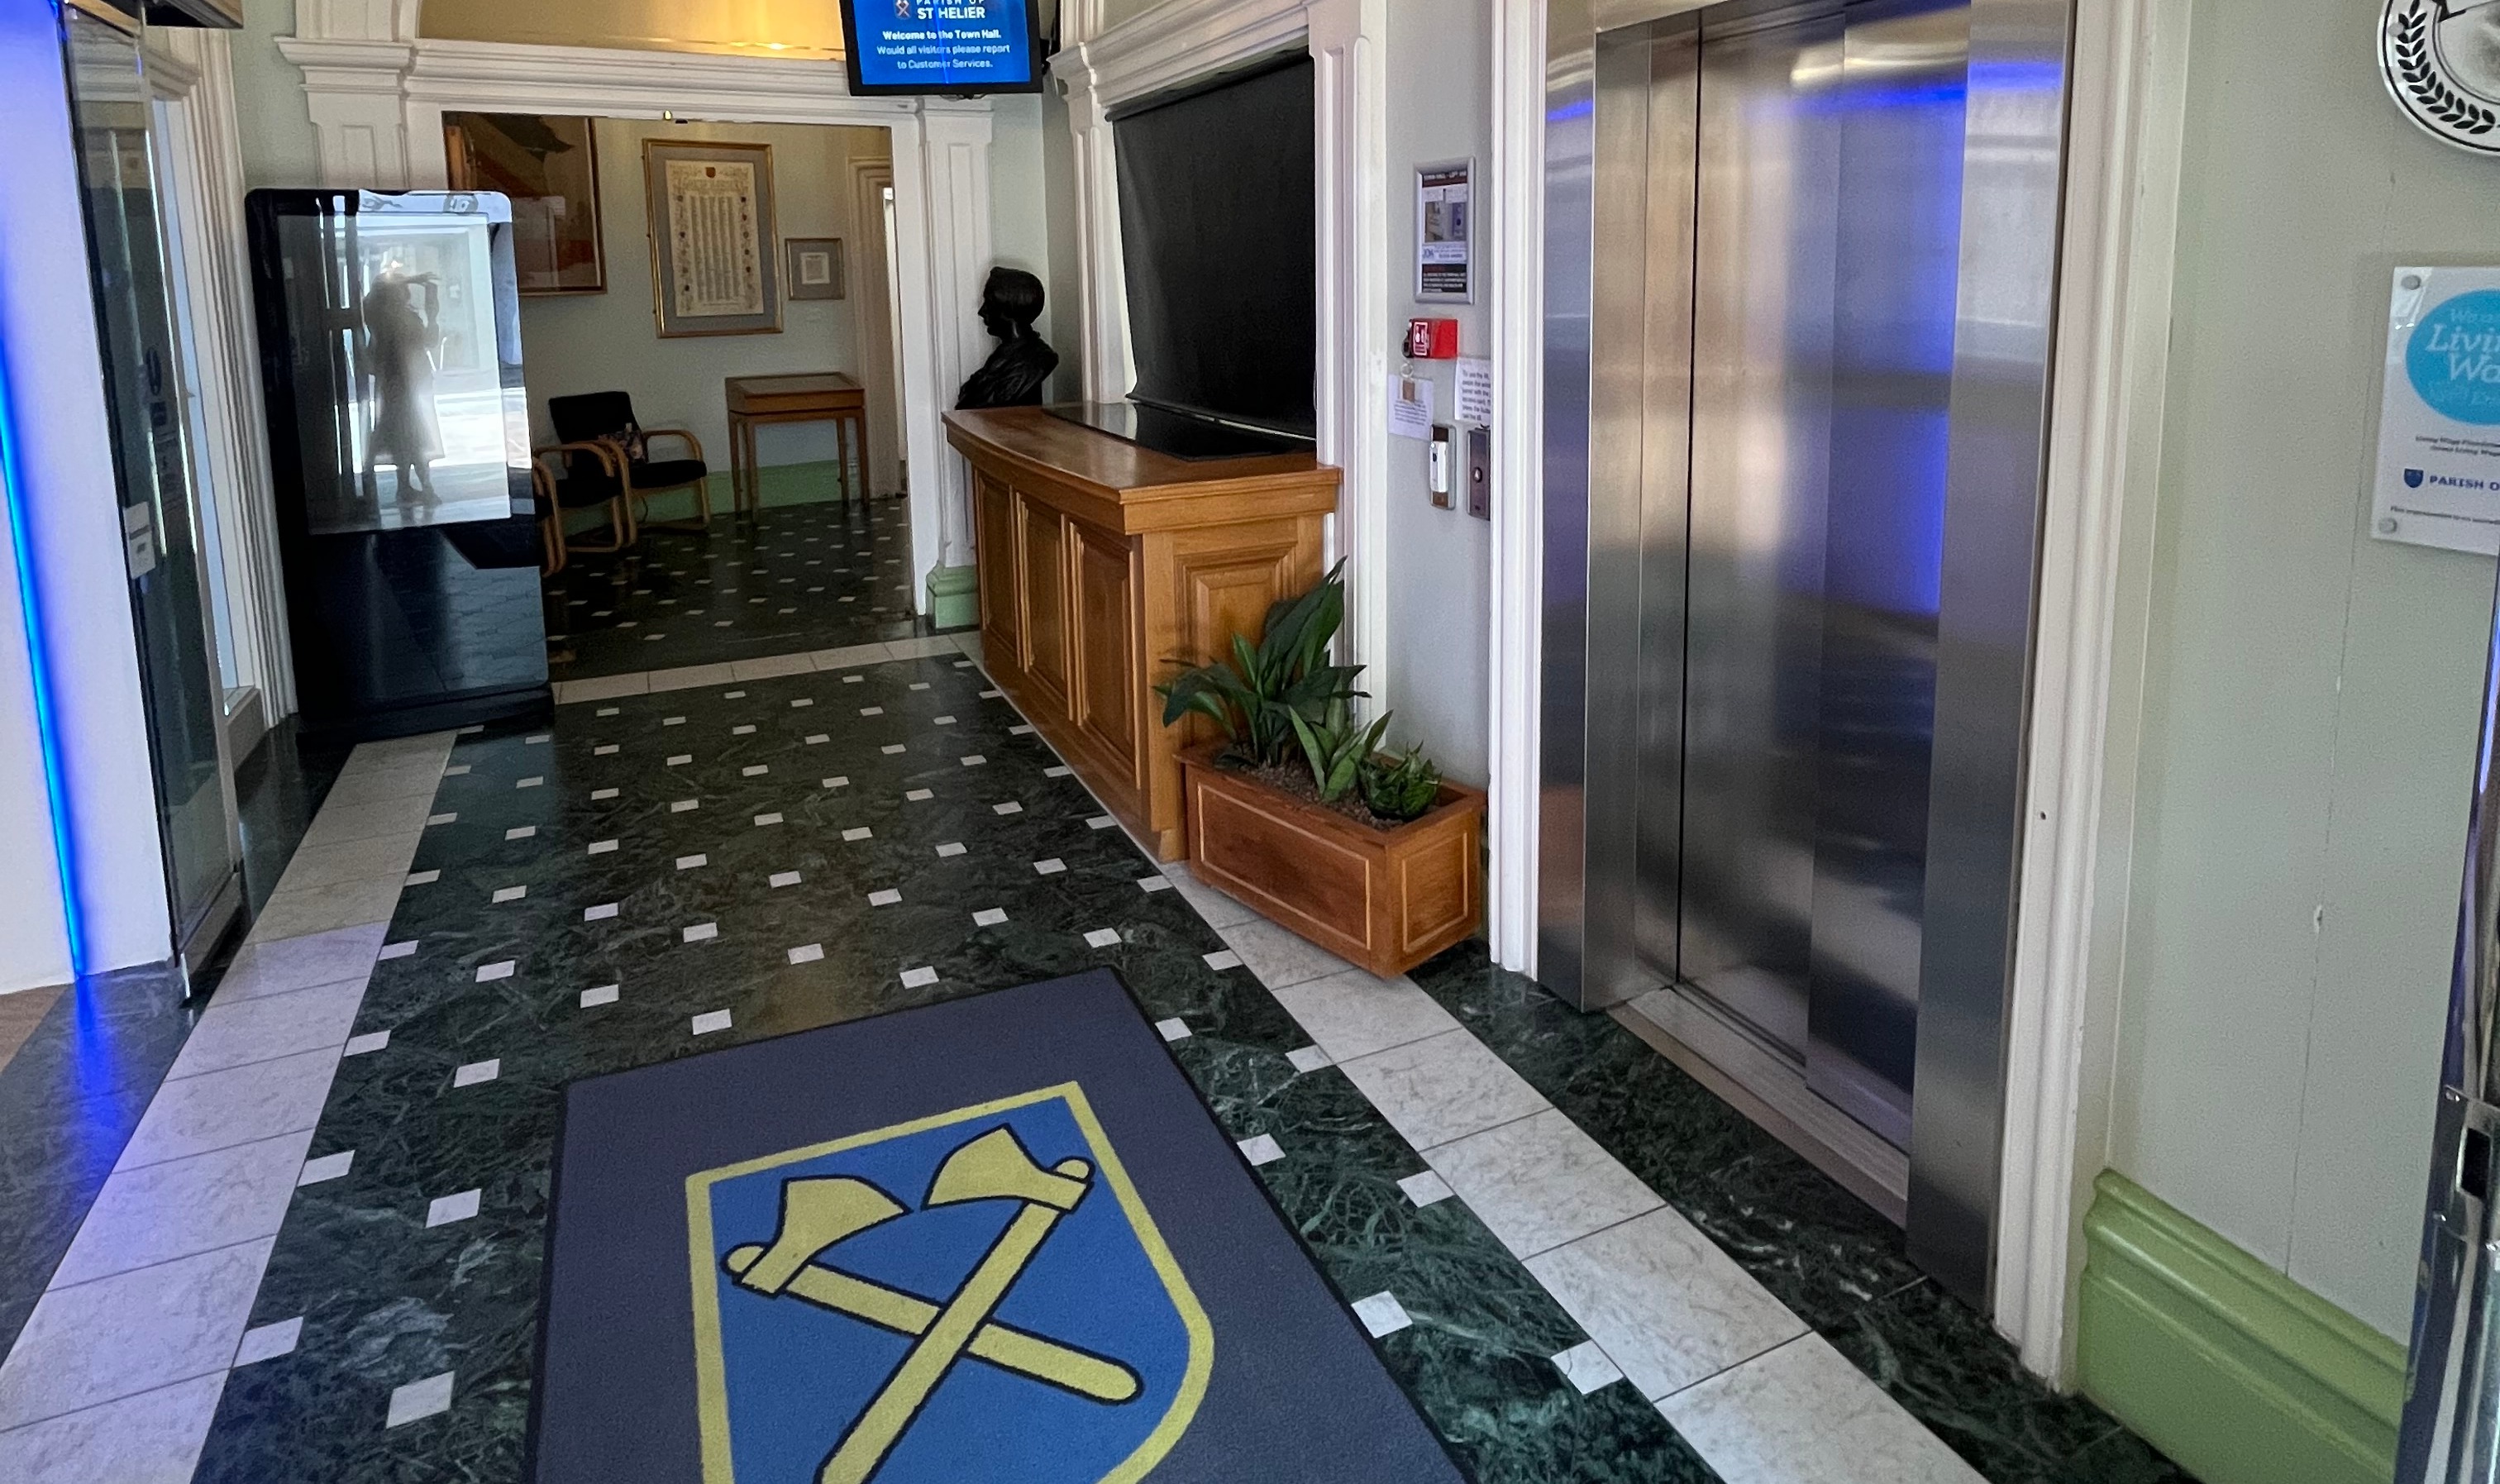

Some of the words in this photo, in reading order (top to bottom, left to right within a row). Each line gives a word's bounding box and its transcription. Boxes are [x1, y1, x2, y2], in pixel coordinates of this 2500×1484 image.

[917, 7, 934, 20] ST
[938, 7, 985, 19] HELIER
[882, 31, 925, 41] Welcome
[926, 31, 937, 40] to
[938, 30, 953, 40] the
[954, 30, 980, 39] Town
[981, 29, 1002, 39] Hall.
[876, 45, 905, 55] Would
[906, 45, 917, 55] all
[918, 45, 951, 55] visitors
[952, 45, 980, 55] please
[982, 44, 1010, 55] report
[897, 60, 907, 69] to
[908, 60, 951, 69] Customer
[952, 59, 994, 69] Services.
[2429, 475, 2484, 489] PARISH
